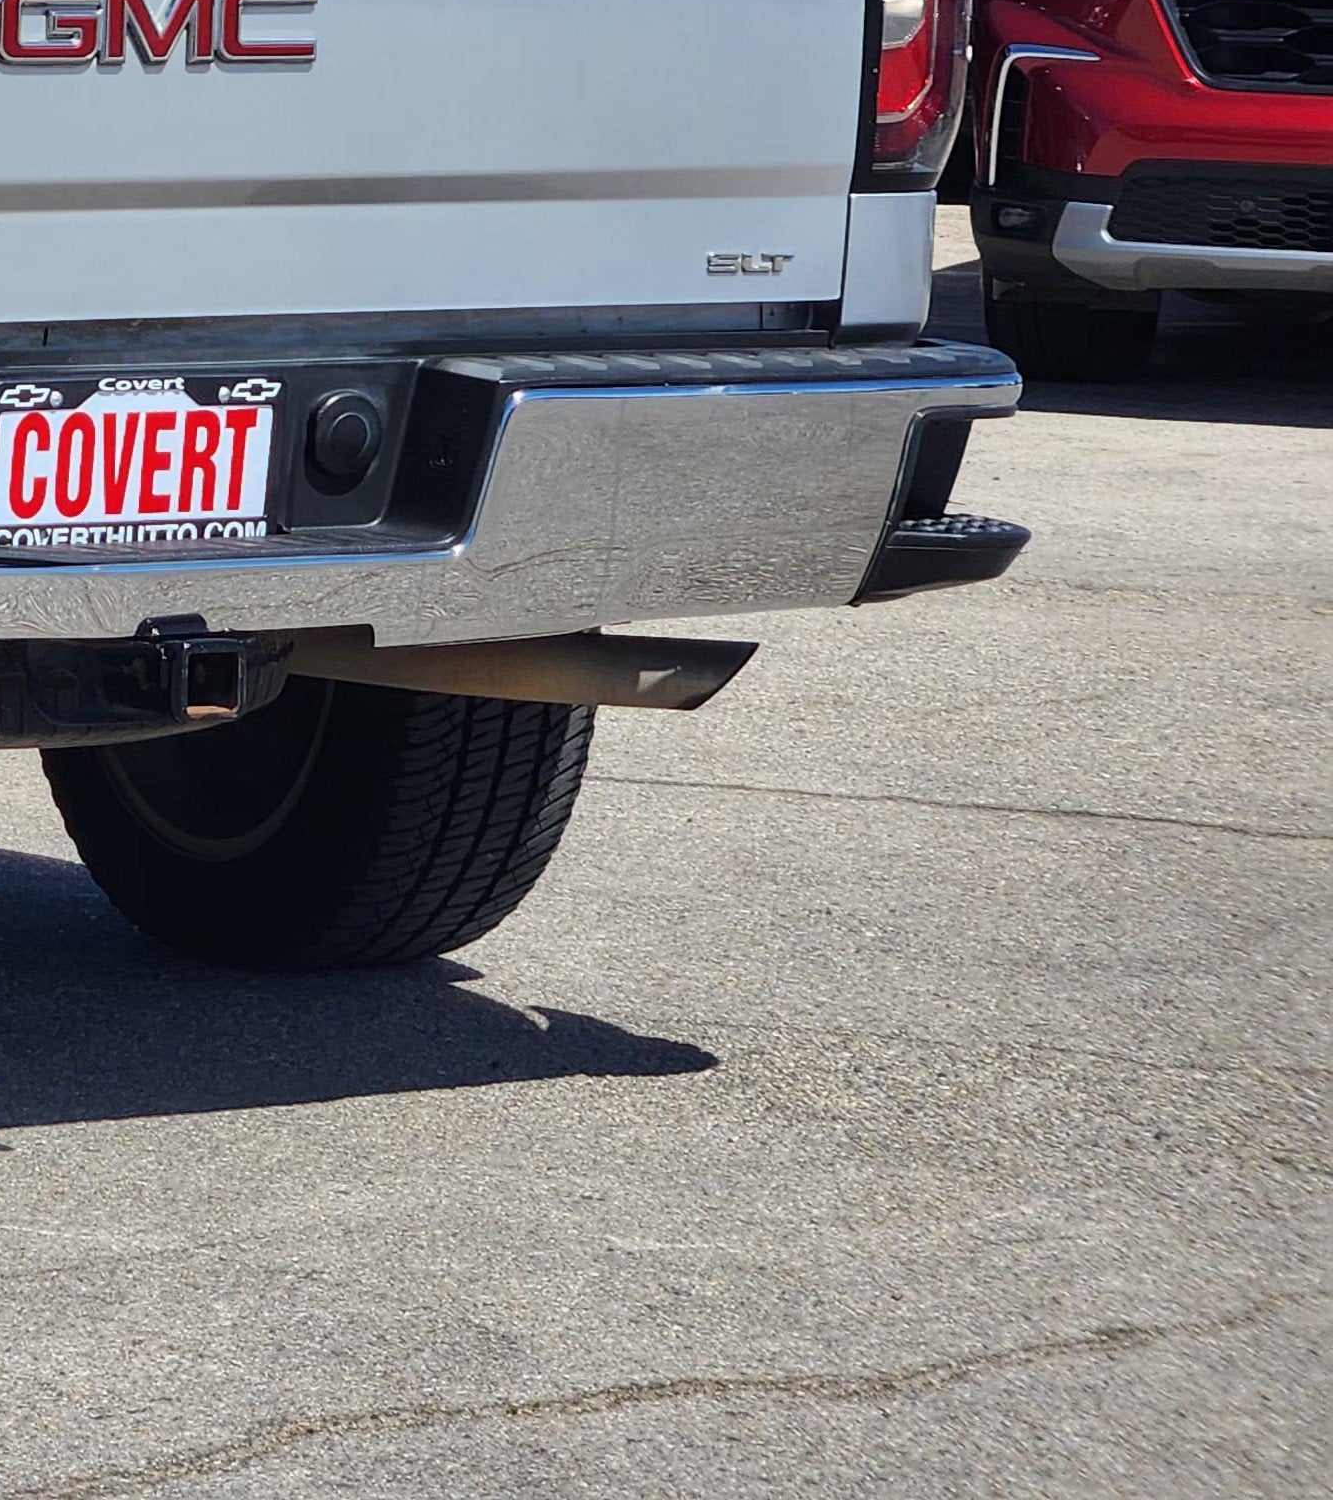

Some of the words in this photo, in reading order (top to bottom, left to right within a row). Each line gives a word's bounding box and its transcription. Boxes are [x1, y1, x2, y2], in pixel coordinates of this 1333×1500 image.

[706, 252, 794, 276] SLT
[98, 377, 184, 392] Covert
[8, 407, 262, 519] COVERT
